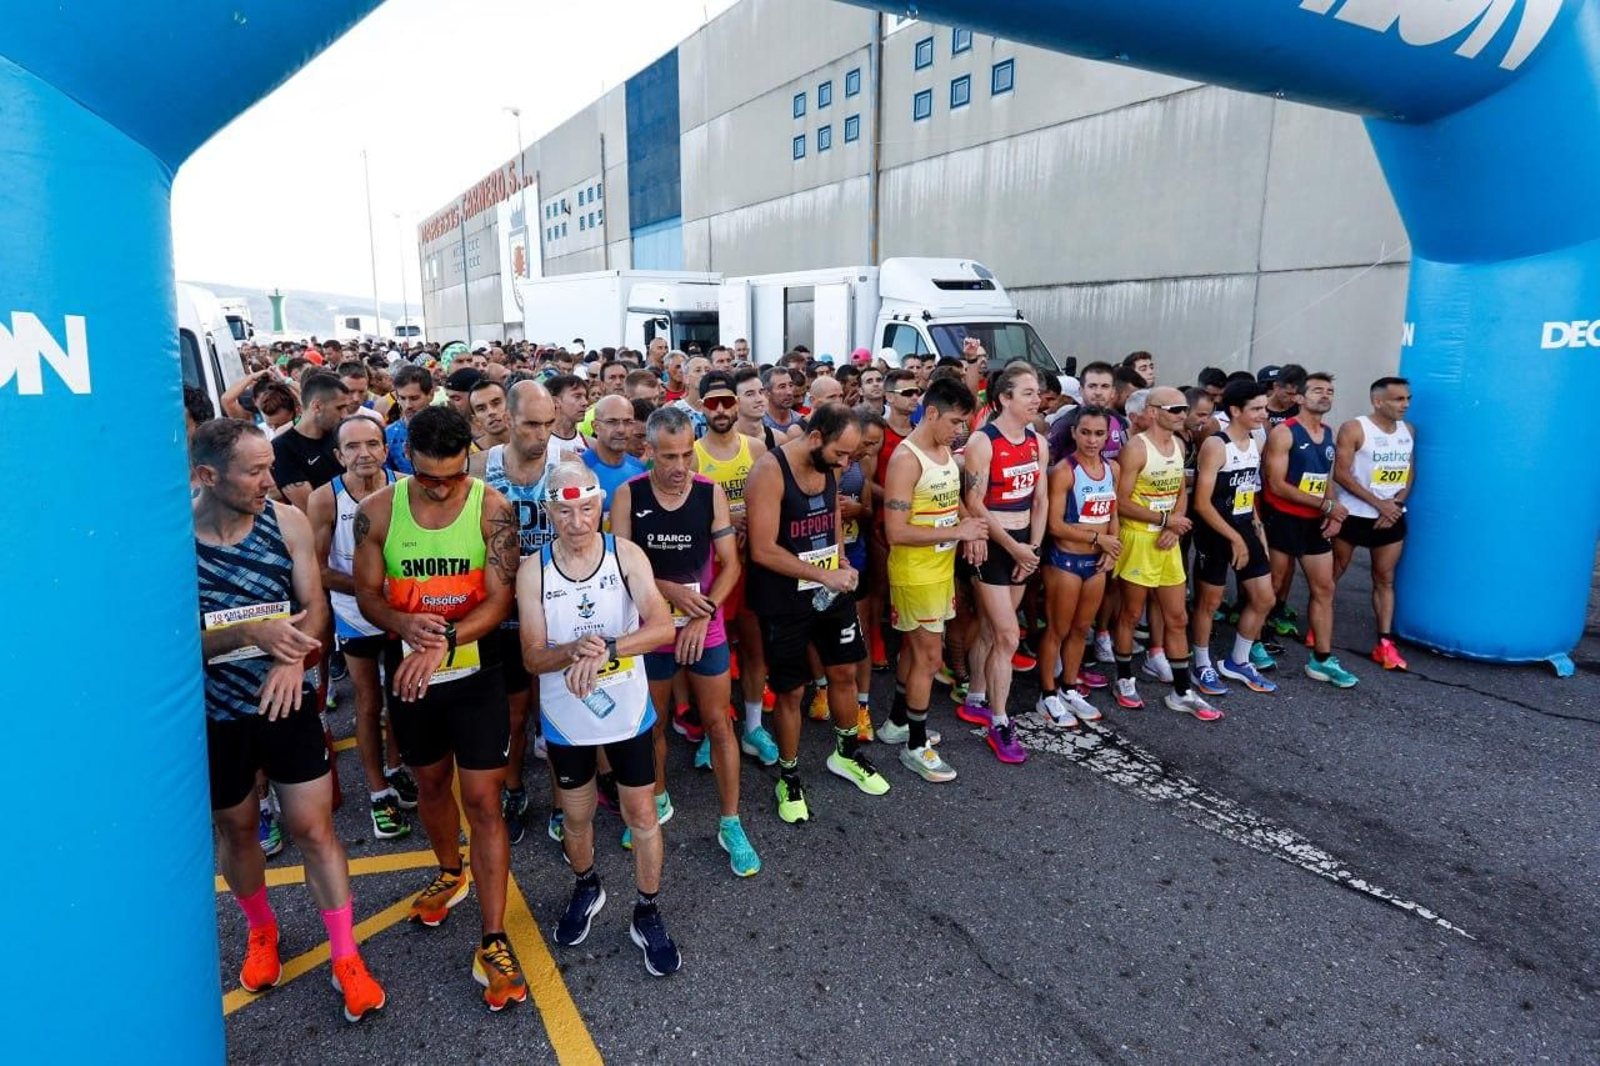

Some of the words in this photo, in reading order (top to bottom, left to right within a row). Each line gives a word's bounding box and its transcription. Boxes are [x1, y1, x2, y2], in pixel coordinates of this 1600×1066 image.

[1011, 473, 1035, 490] 429
[1379, 470, 1404, 482] 207
[1090, 500, 1111, 515] 468
[646, 533, 655, 542] O
[657, 533, 692, 542] BARCO
[400, 557, 471, 578] 3NORTH
